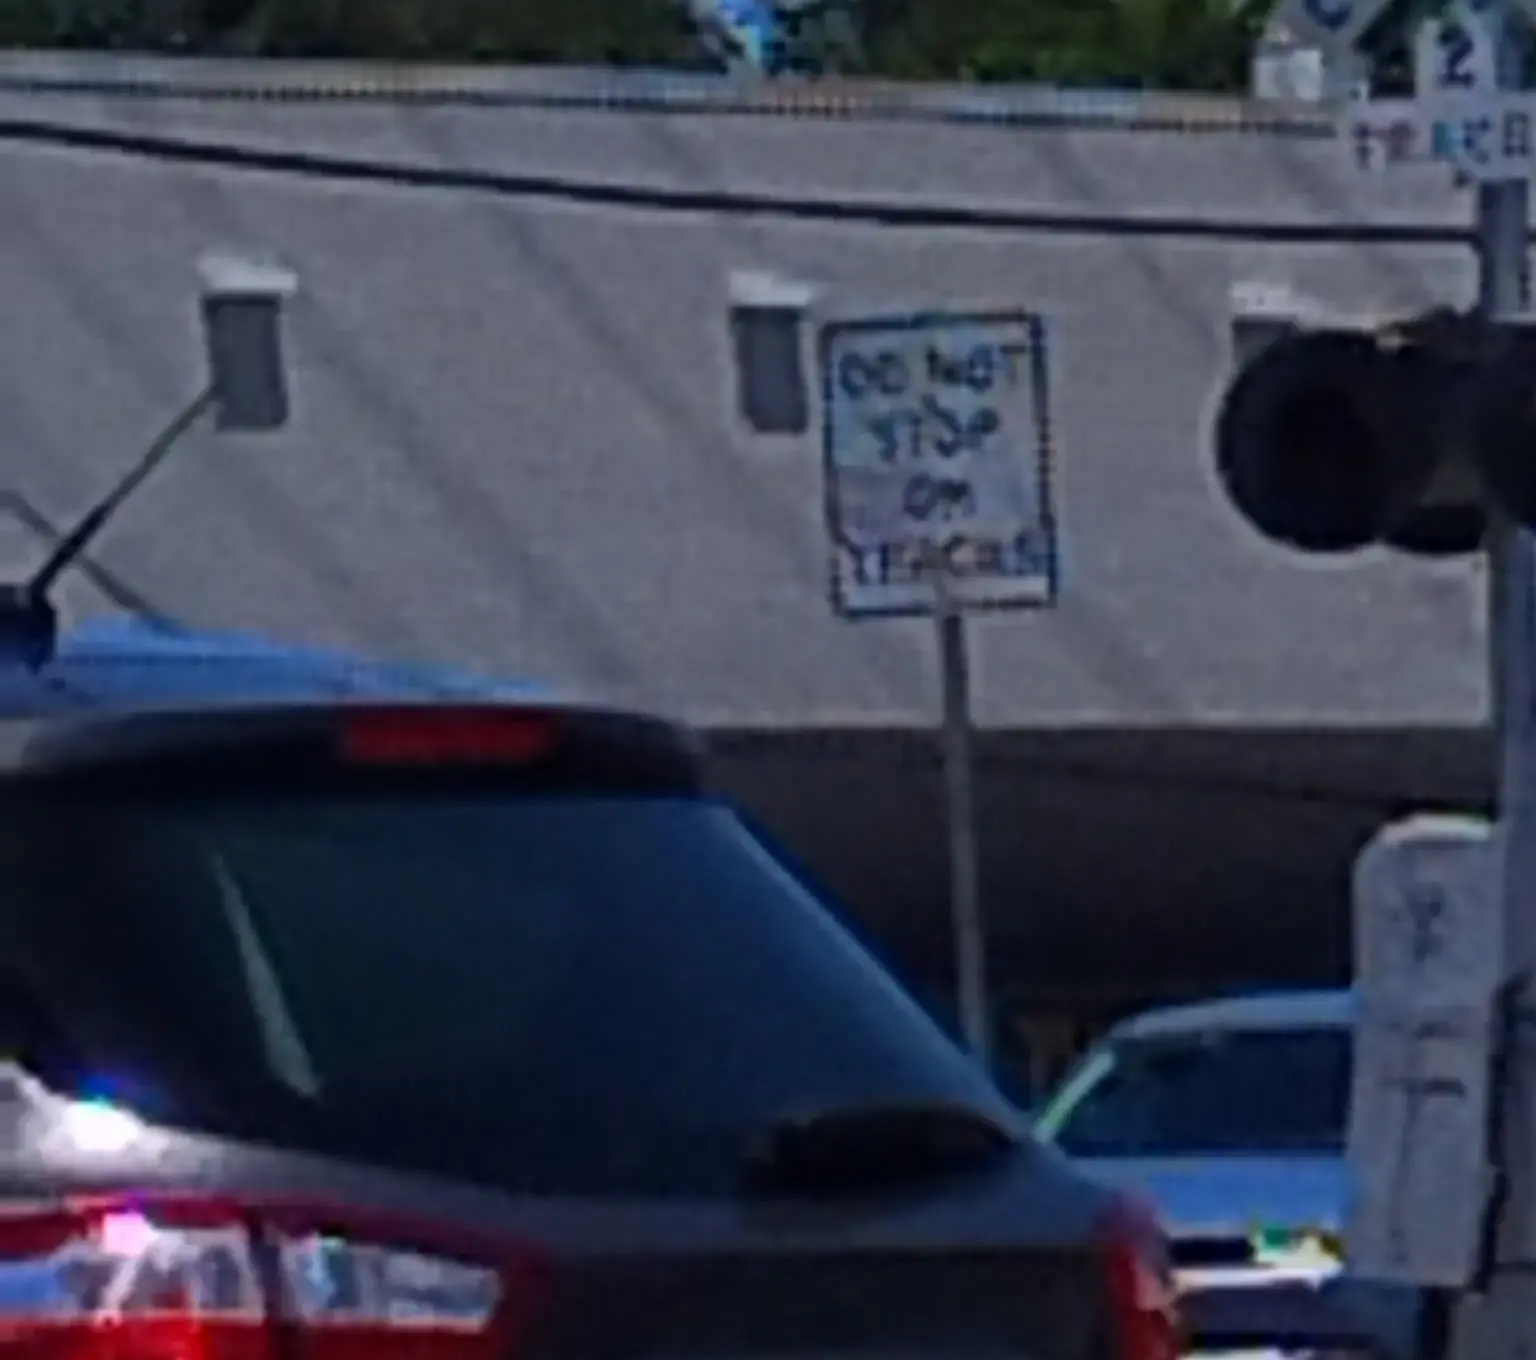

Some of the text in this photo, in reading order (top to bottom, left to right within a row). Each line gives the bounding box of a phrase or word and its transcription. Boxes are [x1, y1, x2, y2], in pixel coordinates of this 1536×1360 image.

[1437, 26, 1476, 87] 2
[838, 343, 1028, 398] DO NOT
[866, 396, 1001, 462] STOP
